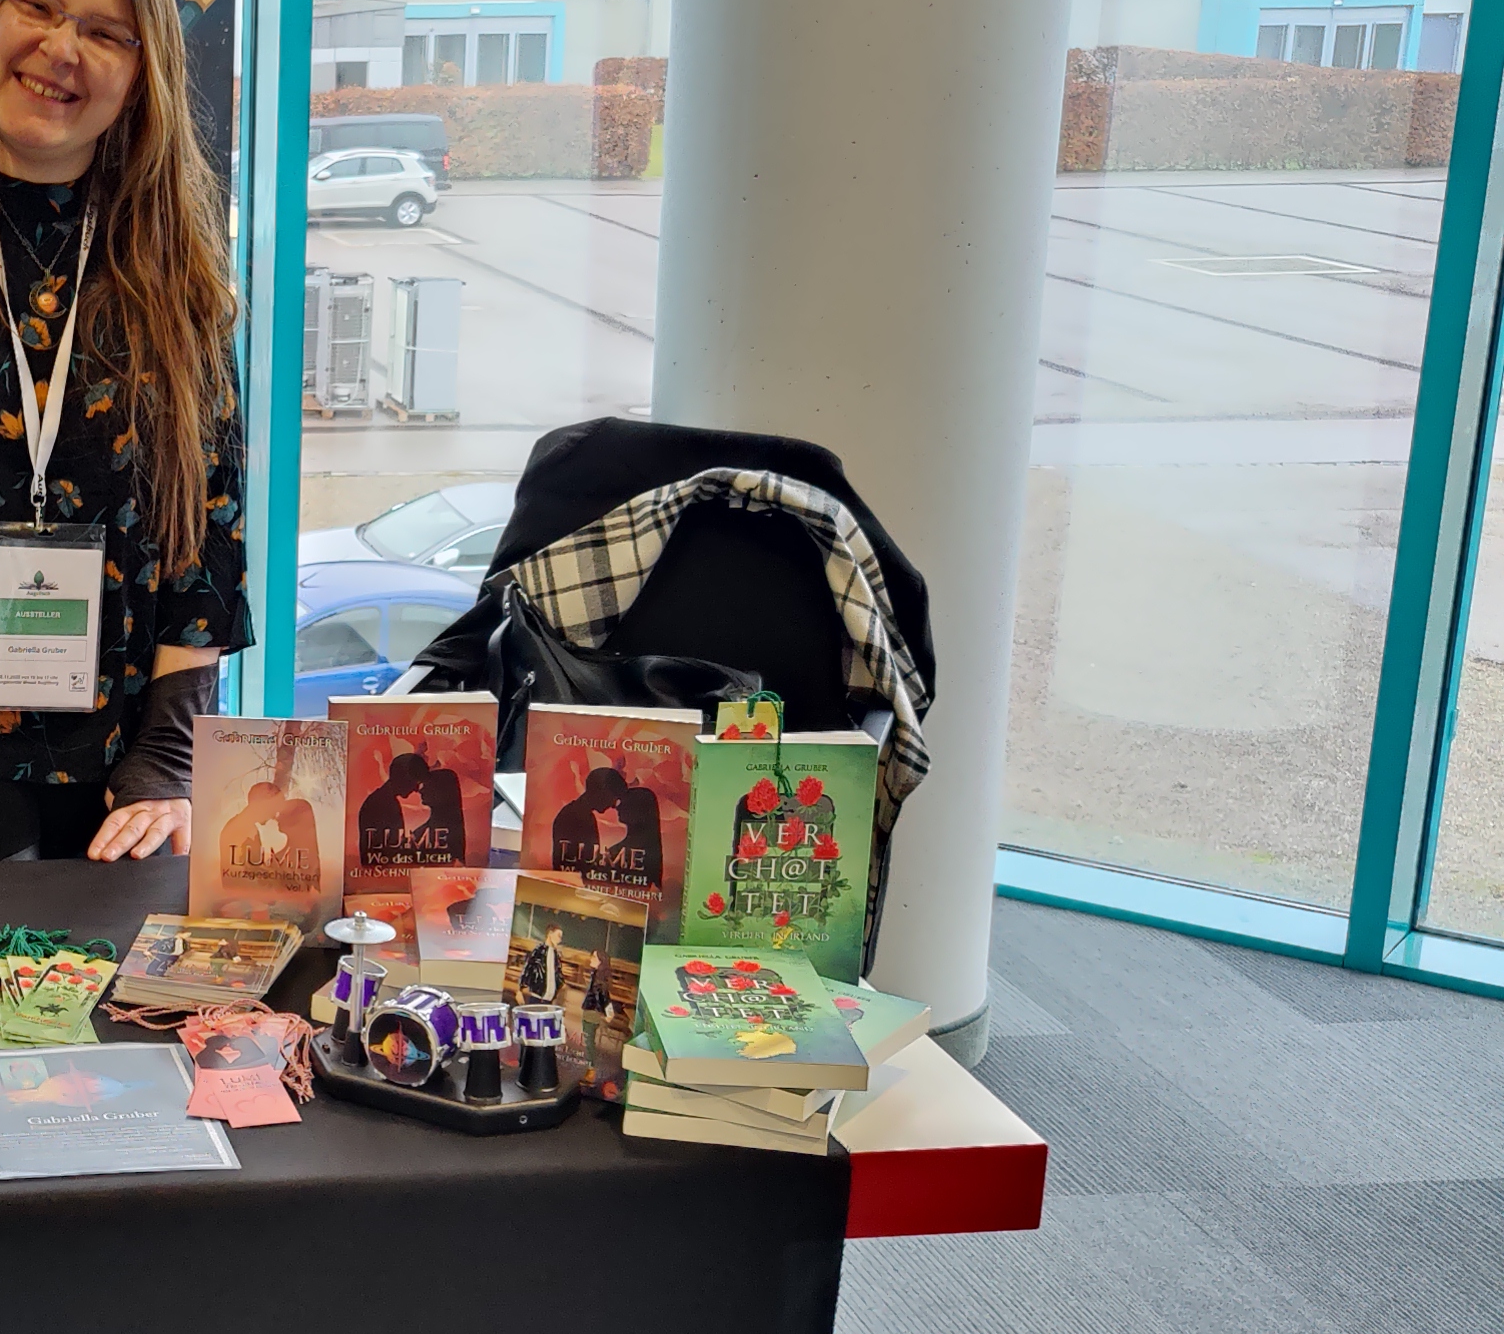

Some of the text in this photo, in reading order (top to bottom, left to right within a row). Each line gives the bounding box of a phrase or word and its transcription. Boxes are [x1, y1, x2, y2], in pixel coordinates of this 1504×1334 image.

[794, 763, 829, 772] GRUBER
[222, 868, 320, 882] Kurzgeschichten
[27, 1113, 99, 1126] Gabriella
[102, 1109, 160, 1121] Gruber
